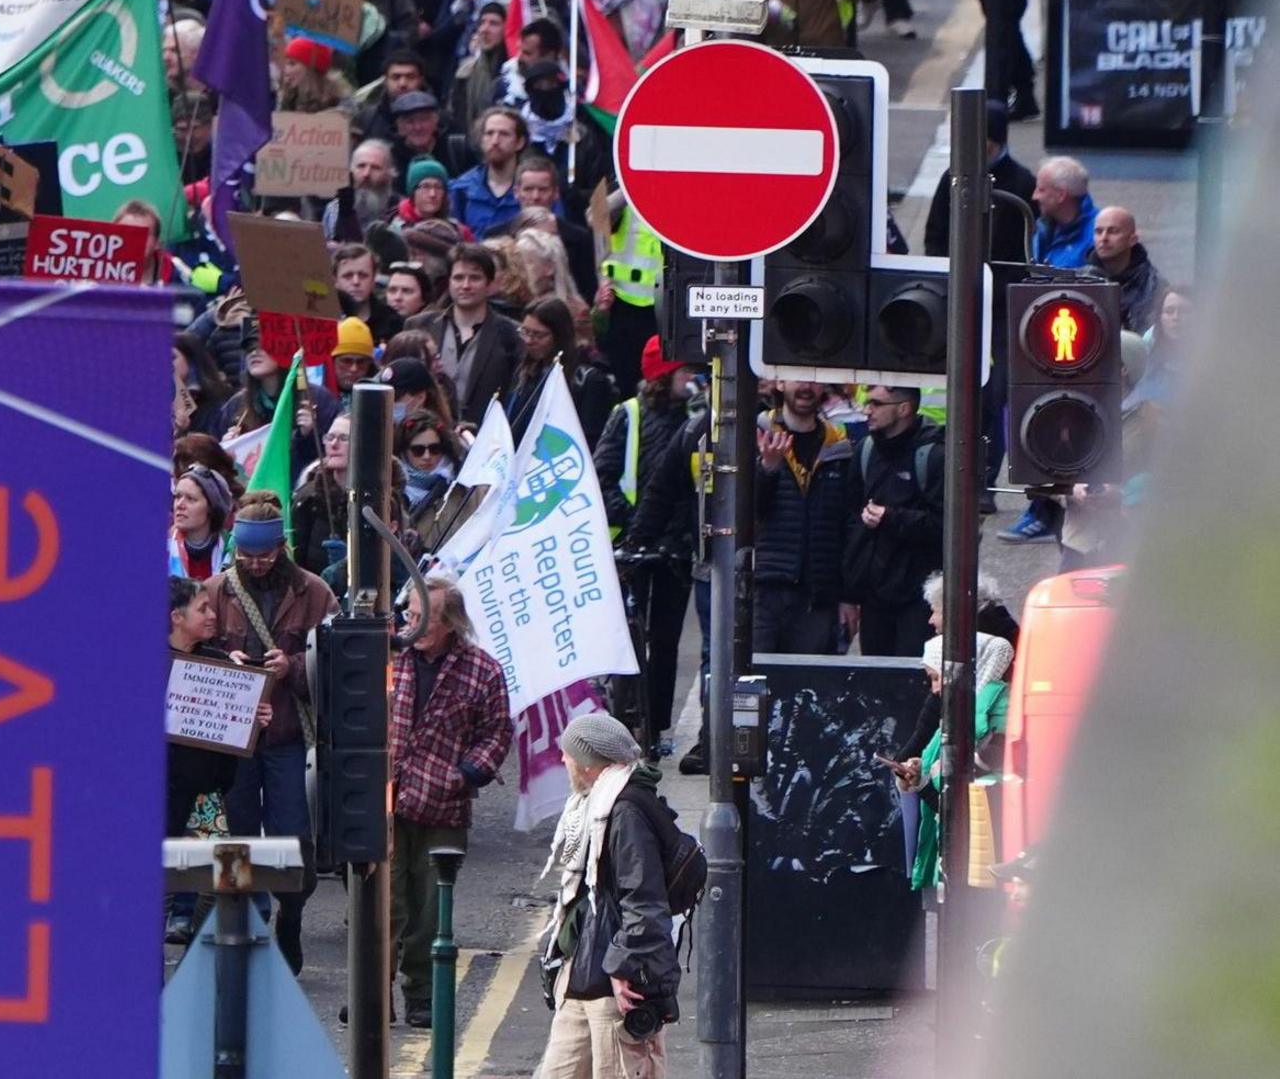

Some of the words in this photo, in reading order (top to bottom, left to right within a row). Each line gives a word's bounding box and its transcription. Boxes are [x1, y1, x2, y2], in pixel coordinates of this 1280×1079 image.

[1107, 20, 1177, 52] CALL
[89, 49, 146, 96] QUAKERS
[1096, 51, 1192, 71] BLACK
[48, 227, 124, 260] STOP
[30, 254, 138, 283] HURTING
[694, 304, 707, 313] at
[710, 305, 729, 315] any
[734, 303, 760, 313] time
[695, 291, 712, 302] No
[716, 291, 759, 305] loading
[500, 550, 520, 578] for
[567, 522, 602, 610] Young
[508, 586, 531, 628] the
[532, 534, 578, 669] Reporters
[475, 564, 521, 695] Environment
[183, 672, 252, 692] IMMIGRANTS
[198, 663, 218, 675] YOU
[223, 669, 256, 682] THINK
[192, 685, 213, 696] ARE
[215, 688, 237, 700] THE
[197, 720, 229, 732] YOUR
[215, 711, 229, 721] AS
[179, 726, 225, 742] MORALS
